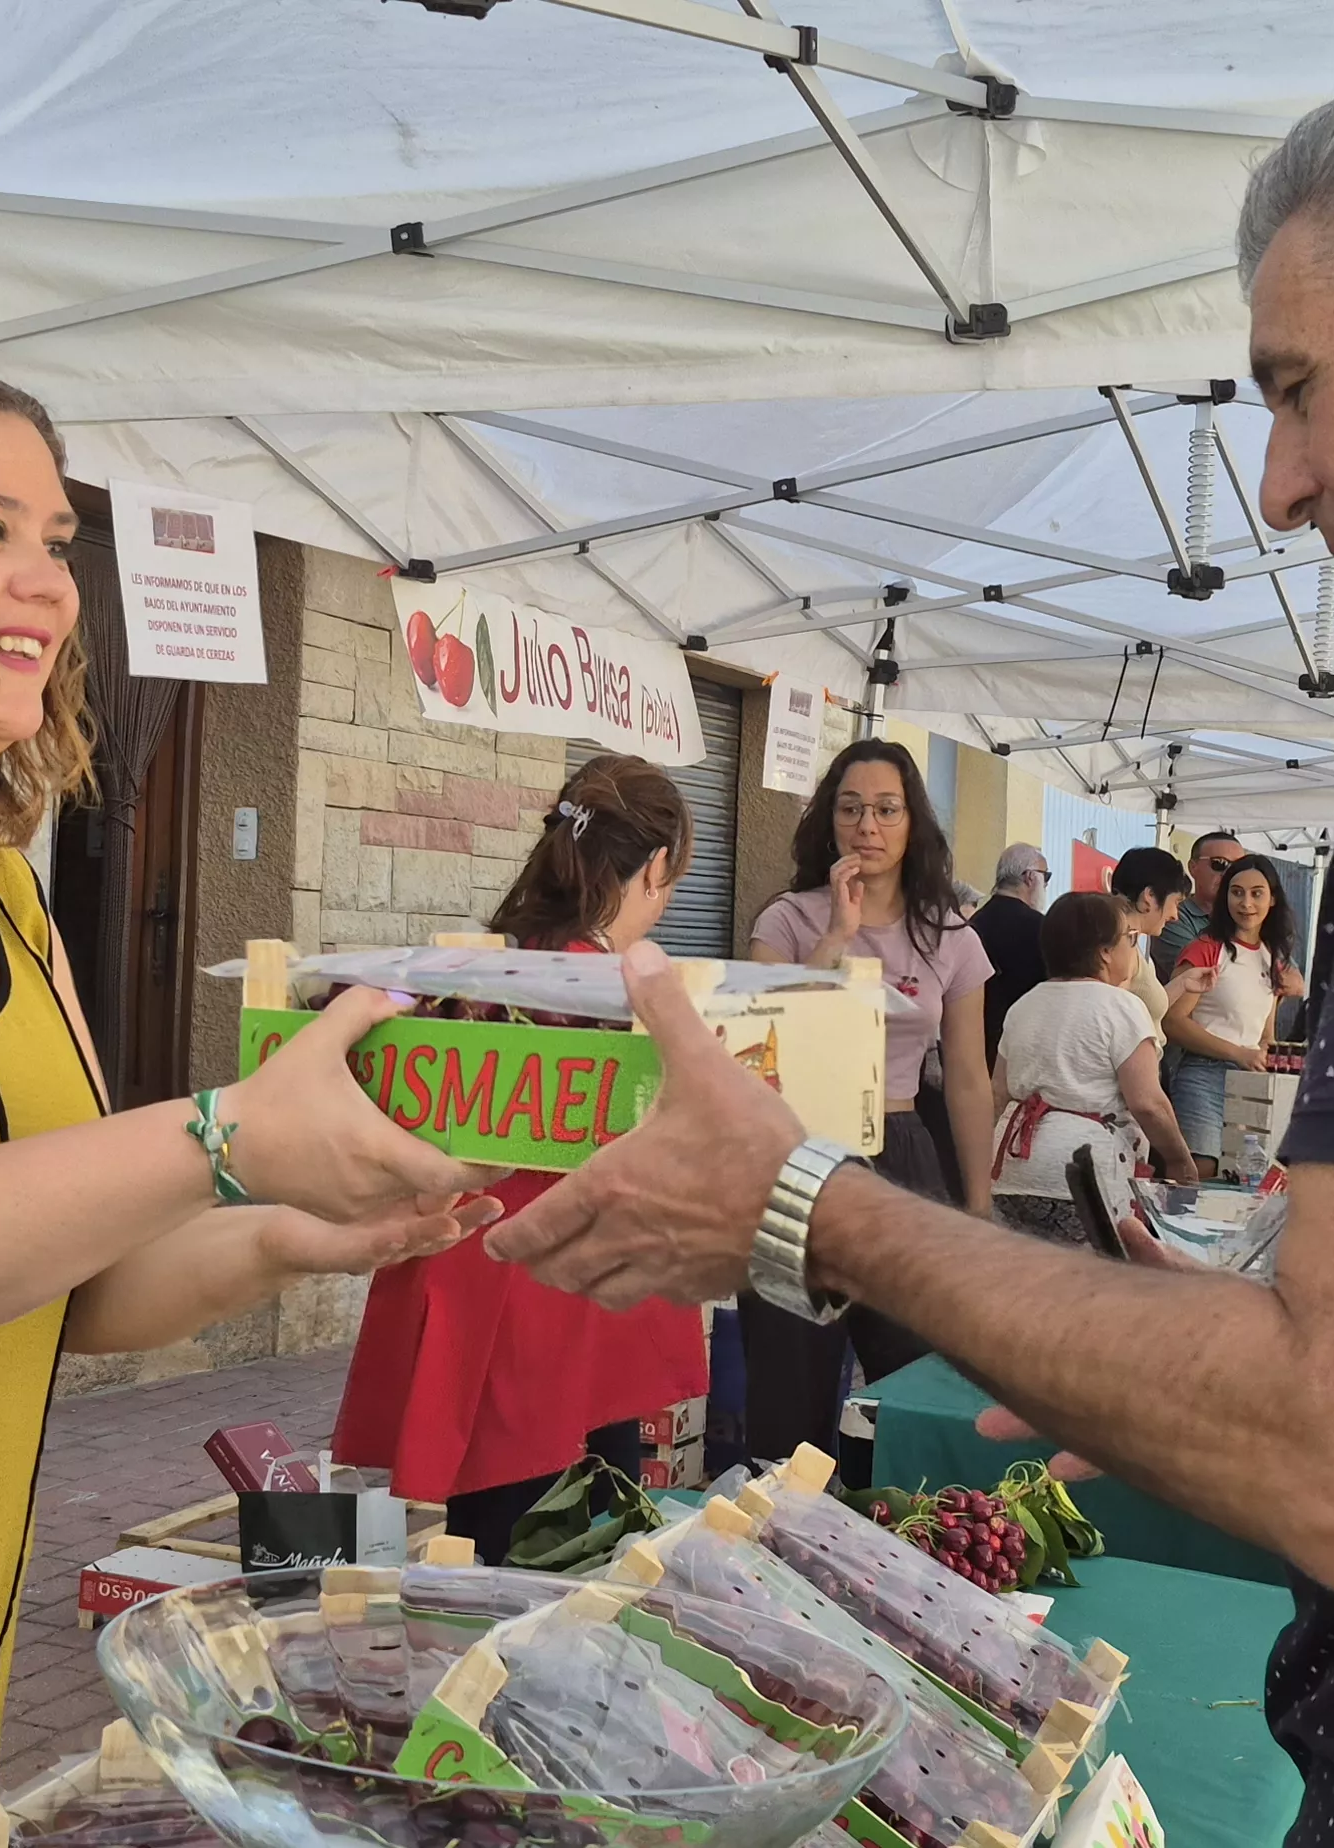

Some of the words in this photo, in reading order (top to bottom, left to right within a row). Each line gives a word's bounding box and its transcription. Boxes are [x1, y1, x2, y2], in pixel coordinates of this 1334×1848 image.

[132, 573, 142, 584] LES
[144, 575, 192, 591] INFORMAMOS
[194, 581, 203, 591] DE
[204, 582, 219, 594] QUE
[221, 585, 231, 595] EN
[233, 586, 247, 596] LOS
[145, 597, 165, 610] BAJOS
[167, 601, 178, 611] DEL
[181, 602, 236, 616] AYUNTAMIENTO
[148, 620, 182, 633] DISPONEN
[184, 624, 193, 634] DE
[195, 625, 204, 635] UN
[206, 626, 237, 638] SERVICIO
[156, 644, 165, 655] DE
[166, 646, 195, 658] GUARDA
[197, 649, 206, 659] DE
[207, 650, 234, 661] CEREZAS
[500, 611, 572, 711] Julio
[571, 626, 633, 730] Buesa
[640, 685, 681, 753] (Bolea)
[378, 1043, 630, 1146] ISMAEL
